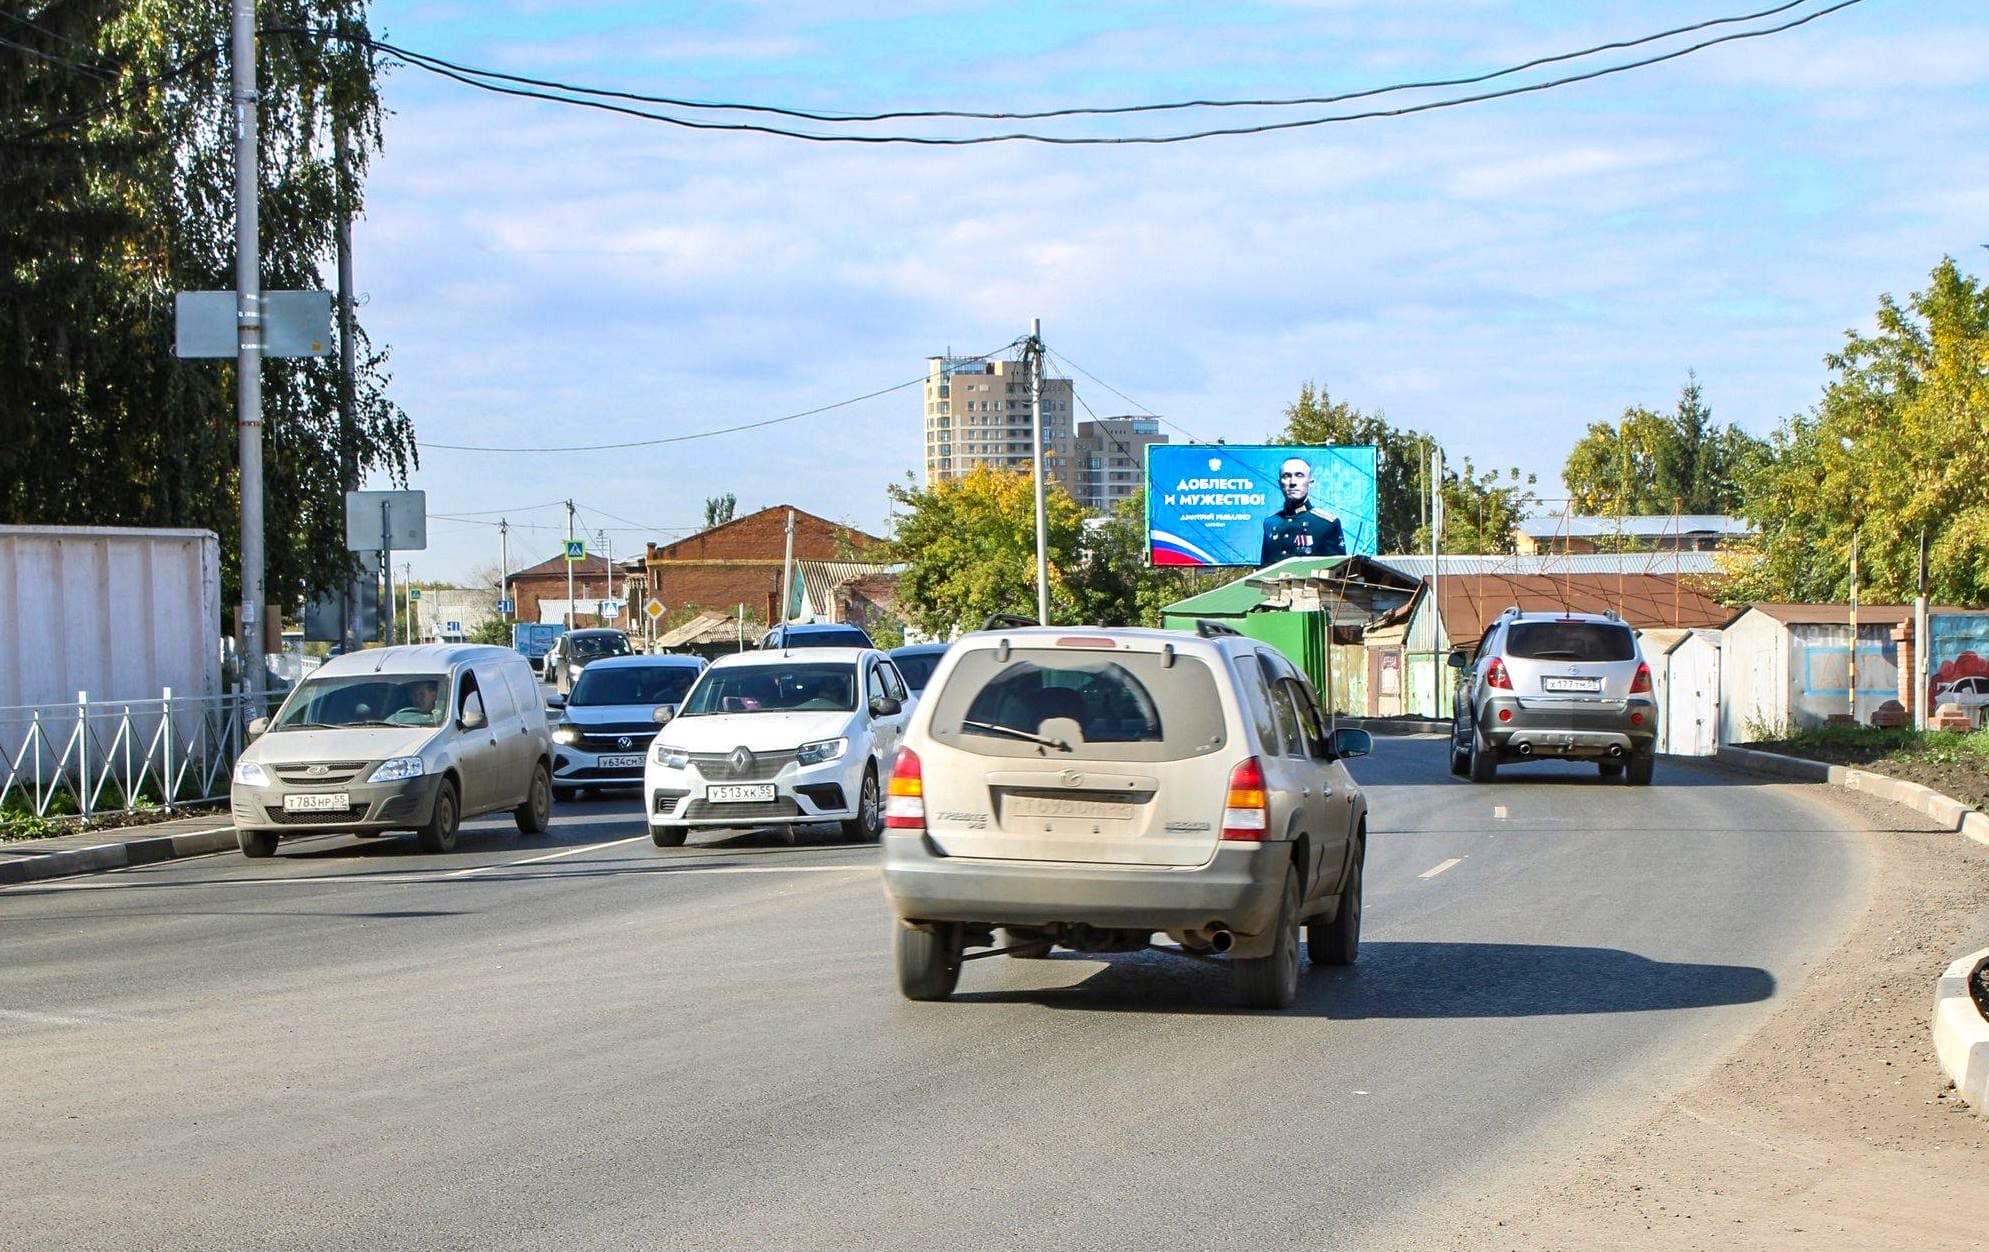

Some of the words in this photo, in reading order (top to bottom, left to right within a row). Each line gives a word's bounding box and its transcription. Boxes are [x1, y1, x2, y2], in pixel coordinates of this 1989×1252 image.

[1177, 478, 1254, 491] ДОБЛЕСТЬ
[1164, 494, 1175, 506] И
[1180, 494, 1266, 506] МУЖЕСТВО!
